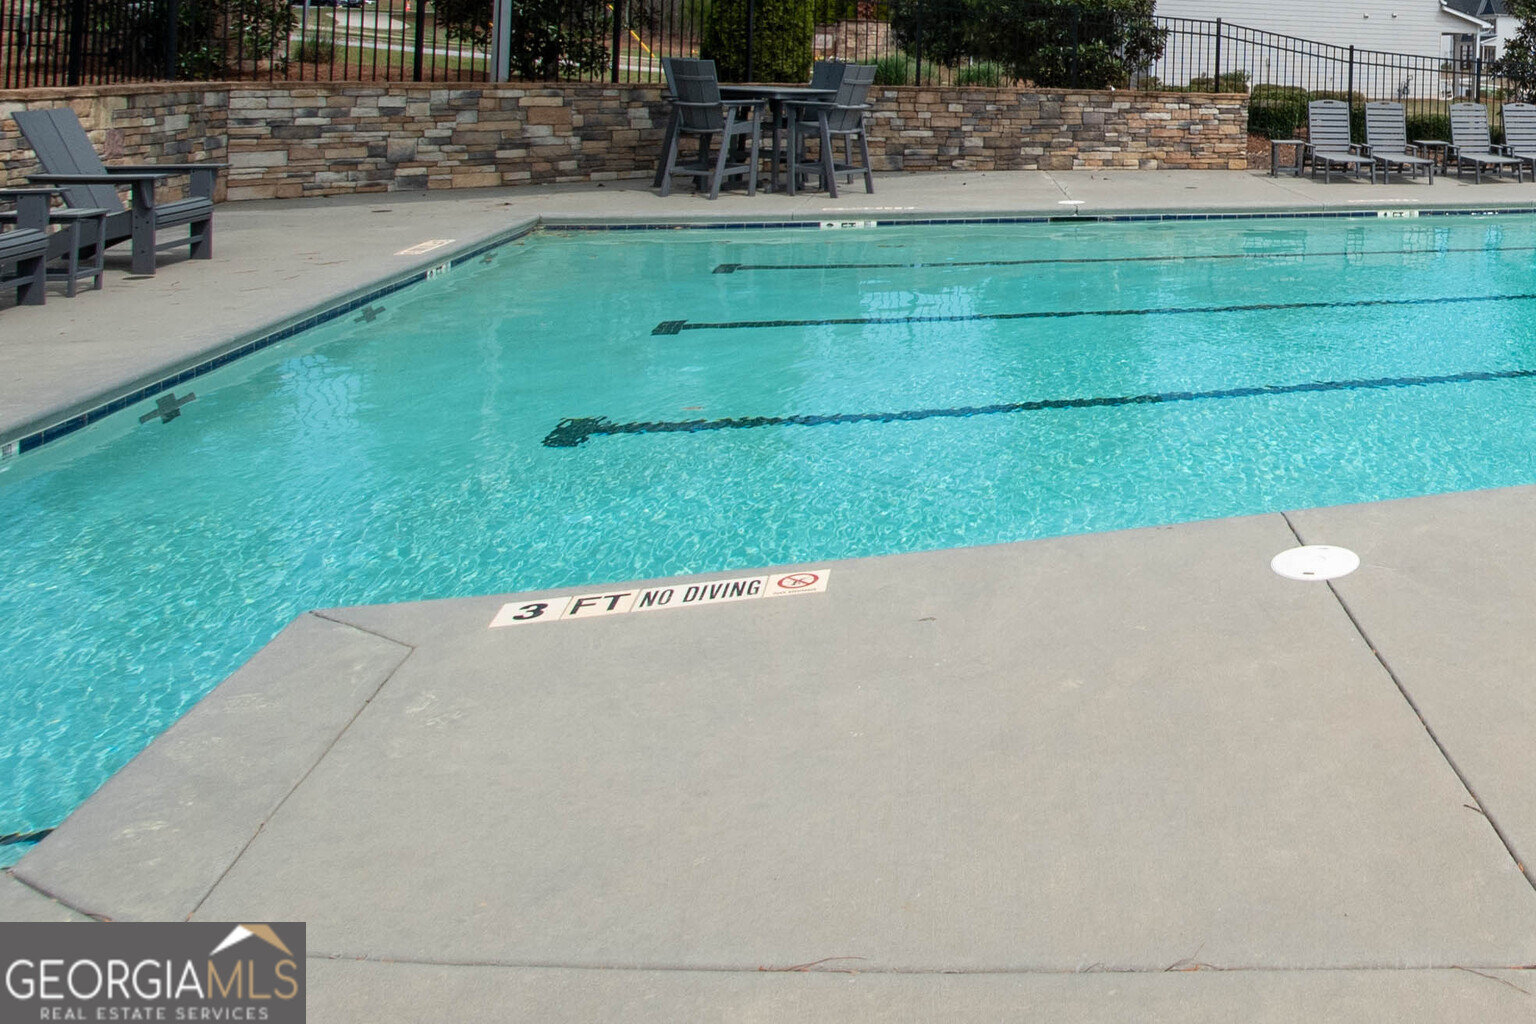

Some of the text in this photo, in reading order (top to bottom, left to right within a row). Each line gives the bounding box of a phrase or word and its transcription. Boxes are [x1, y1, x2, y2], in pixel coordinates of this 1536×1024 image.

[512, 579, 762, 621] 3 FT NO DIVING
